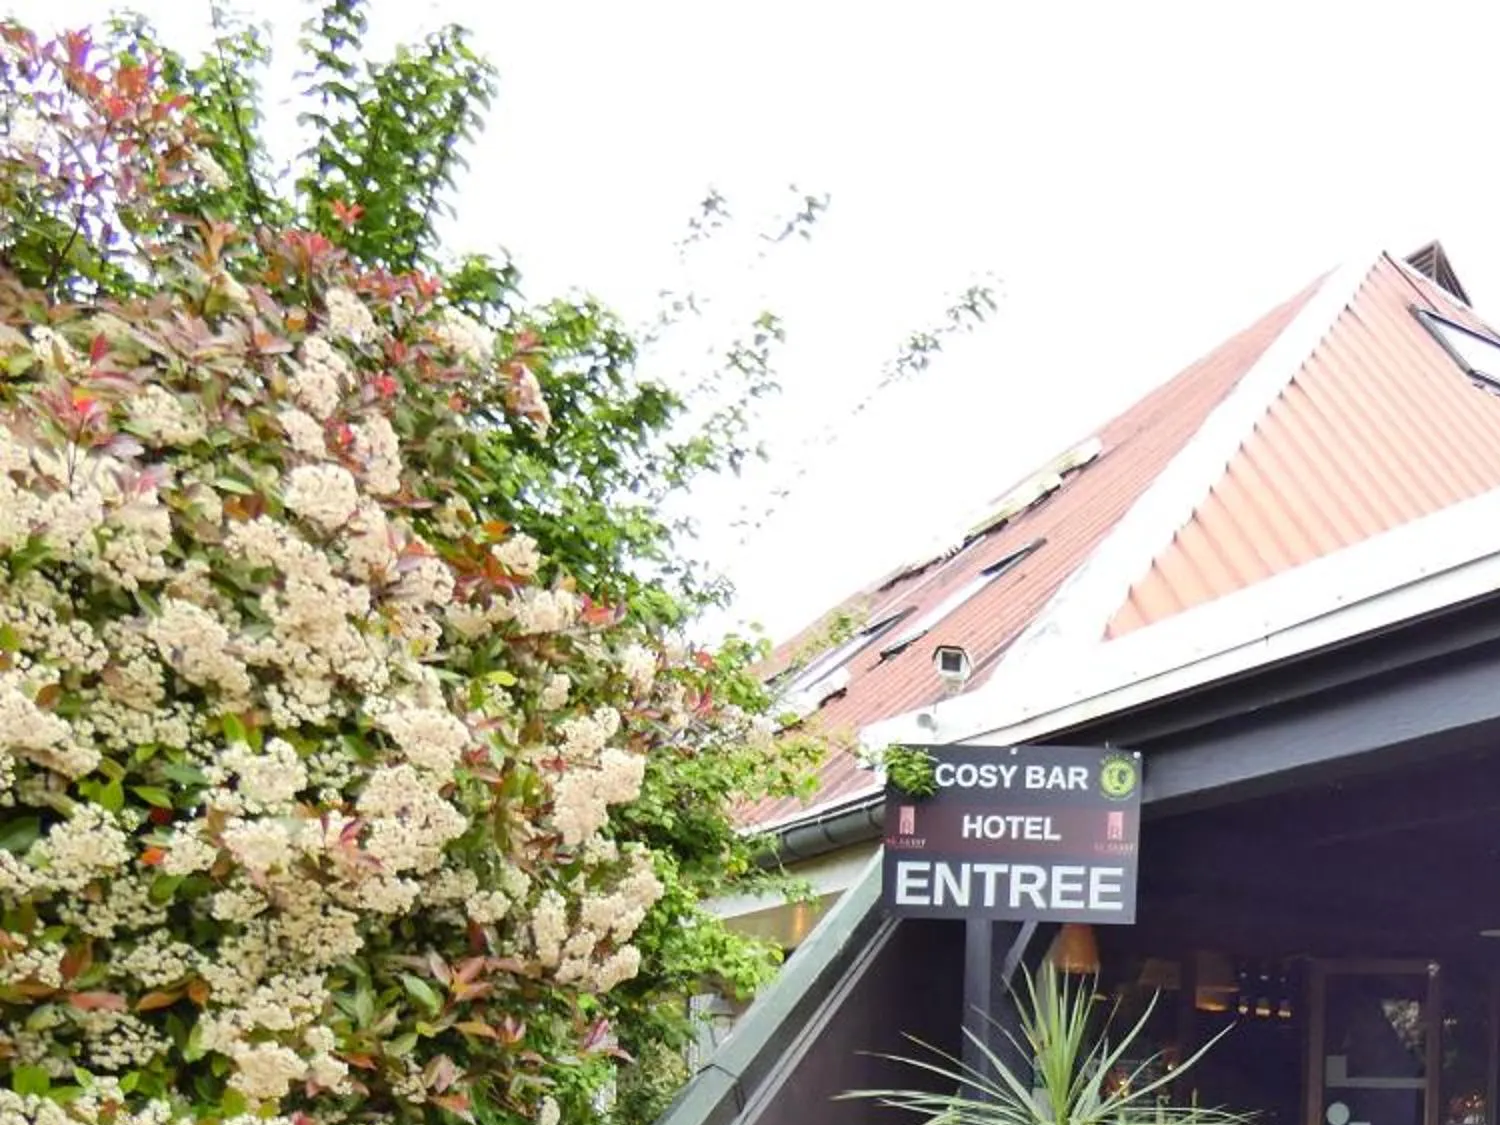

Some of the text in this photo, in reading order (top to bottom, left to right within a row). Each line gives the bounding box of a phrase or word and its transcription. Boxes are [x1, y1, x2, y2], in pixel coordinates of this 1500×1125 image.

[935, 763, 1017, 788] COSY
[1025, 766, 1089, 790] BAR
[962, 813, 1062, 841] HOTEL
[896, 861, 1124, 911] ENTREE
